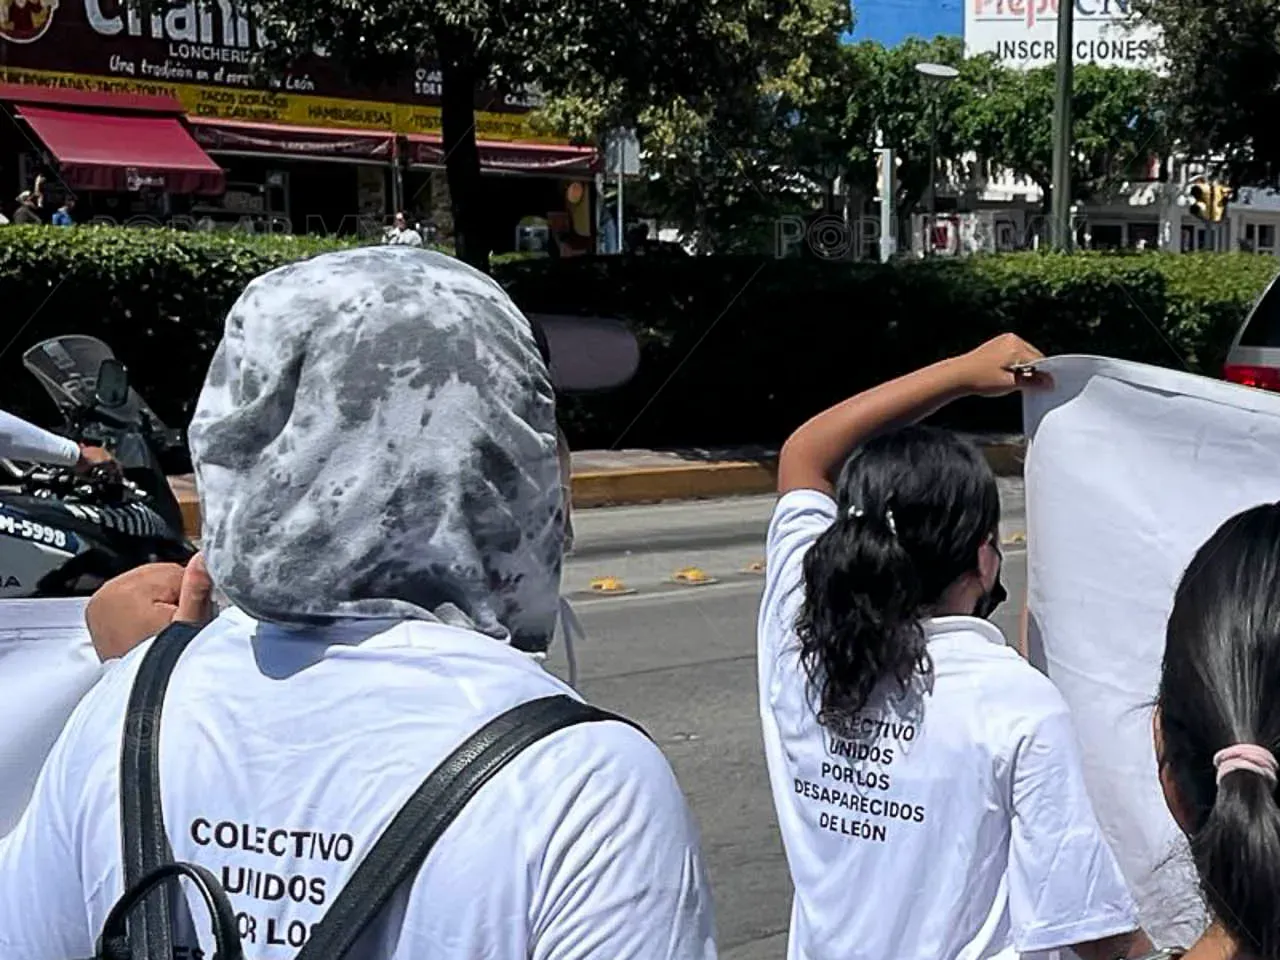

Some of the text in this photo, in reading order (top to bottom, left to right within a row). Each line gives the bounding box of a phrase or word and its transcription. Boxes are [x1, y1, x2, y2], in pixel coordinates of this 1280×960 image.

[996, 40, 1150, 60] INSCRCIONES
[285, 74, 315, 91] León
[830, 738, 894, 765] UNIDOS
[821, 762, 891, 791] POR LOS
[794, 778, 926, 823] DESAPARECIDOS
[190, 817, 356, 862] COLECTIVO
[819, 811, 887, 842] DE LEÓN
